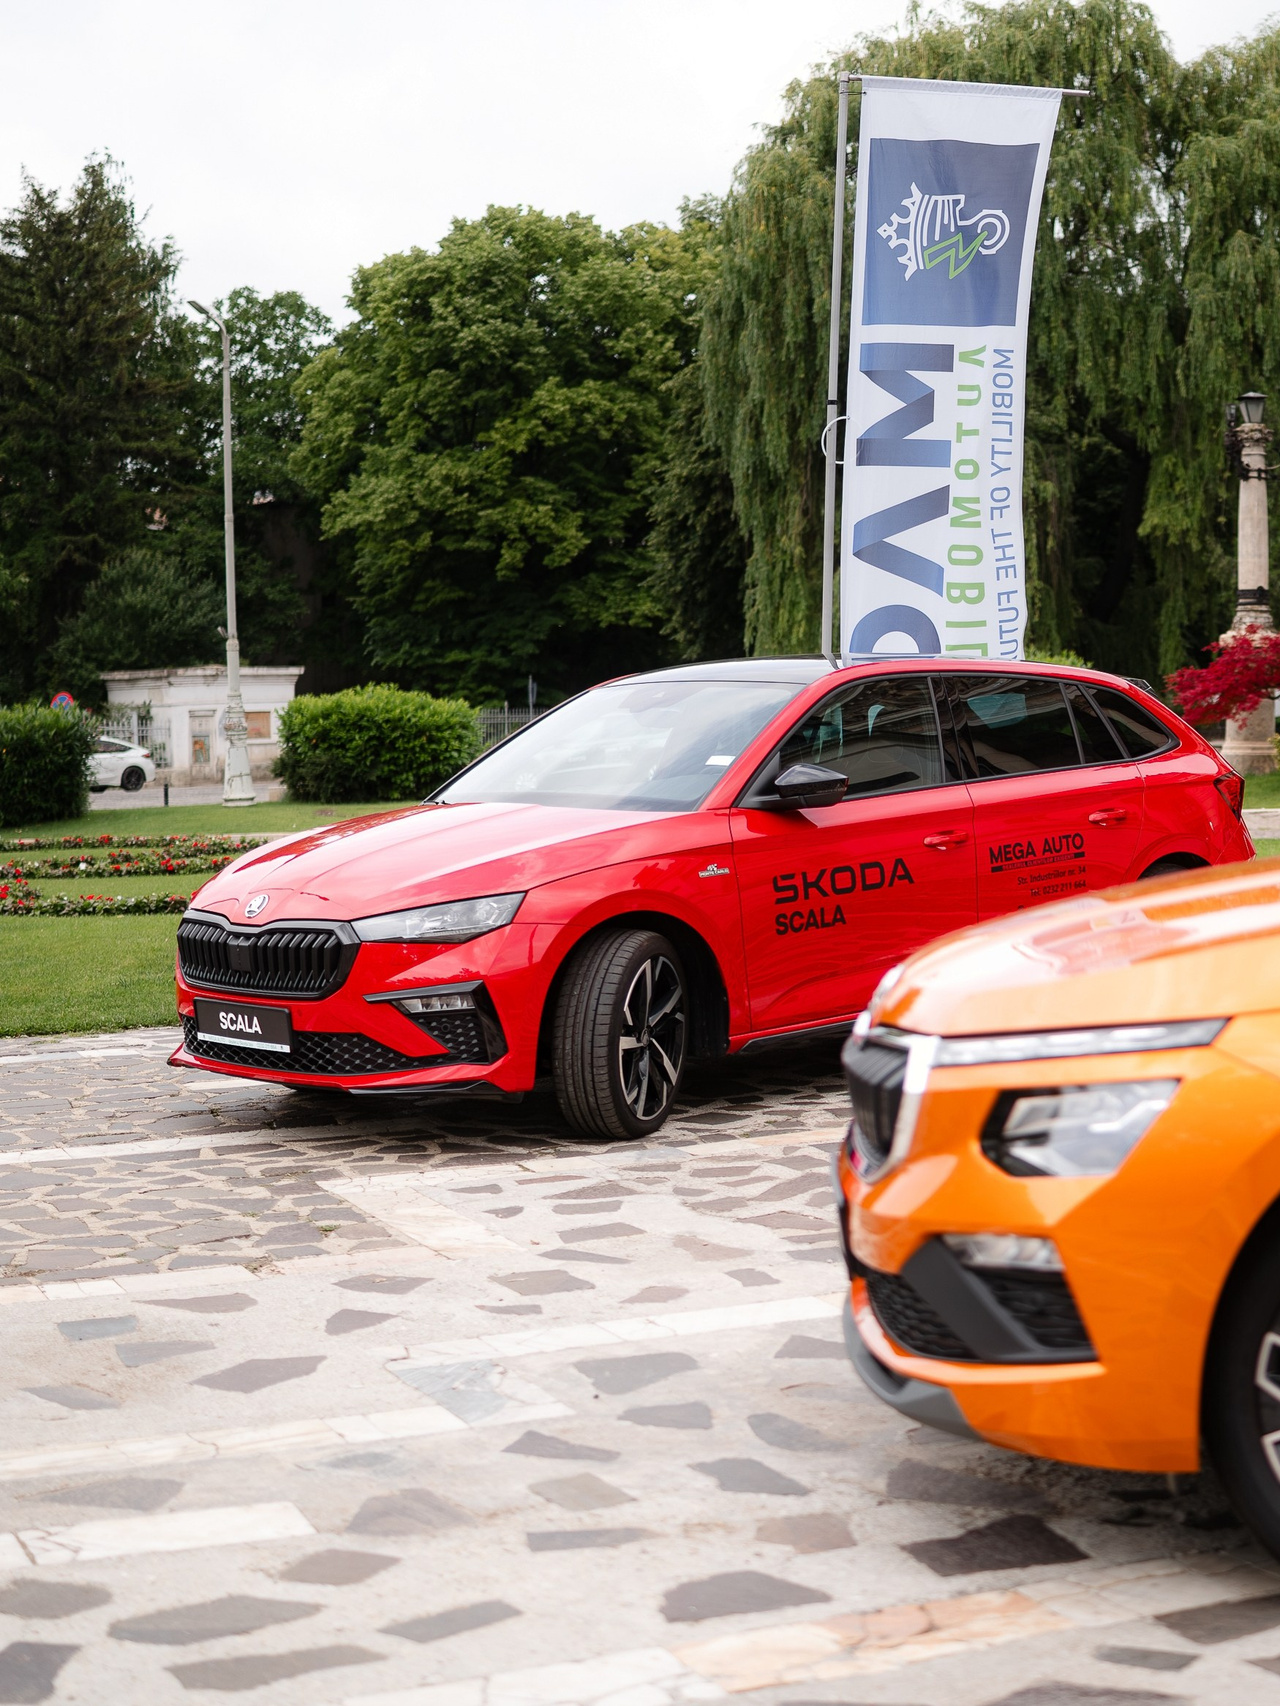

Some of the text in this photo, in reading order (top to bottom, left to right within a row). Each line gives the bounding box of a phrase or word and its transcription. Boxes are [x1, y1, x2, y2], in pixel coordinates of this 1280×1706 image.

[989, 832, 1085, 865] MEGA AUTO
[1042, 883, 1059, 895] 0232
[1060, 881, 1072, 892] 211
[775, 904, 846, 936] SCALA
[219, 1011, 262, 1034] SCALA
